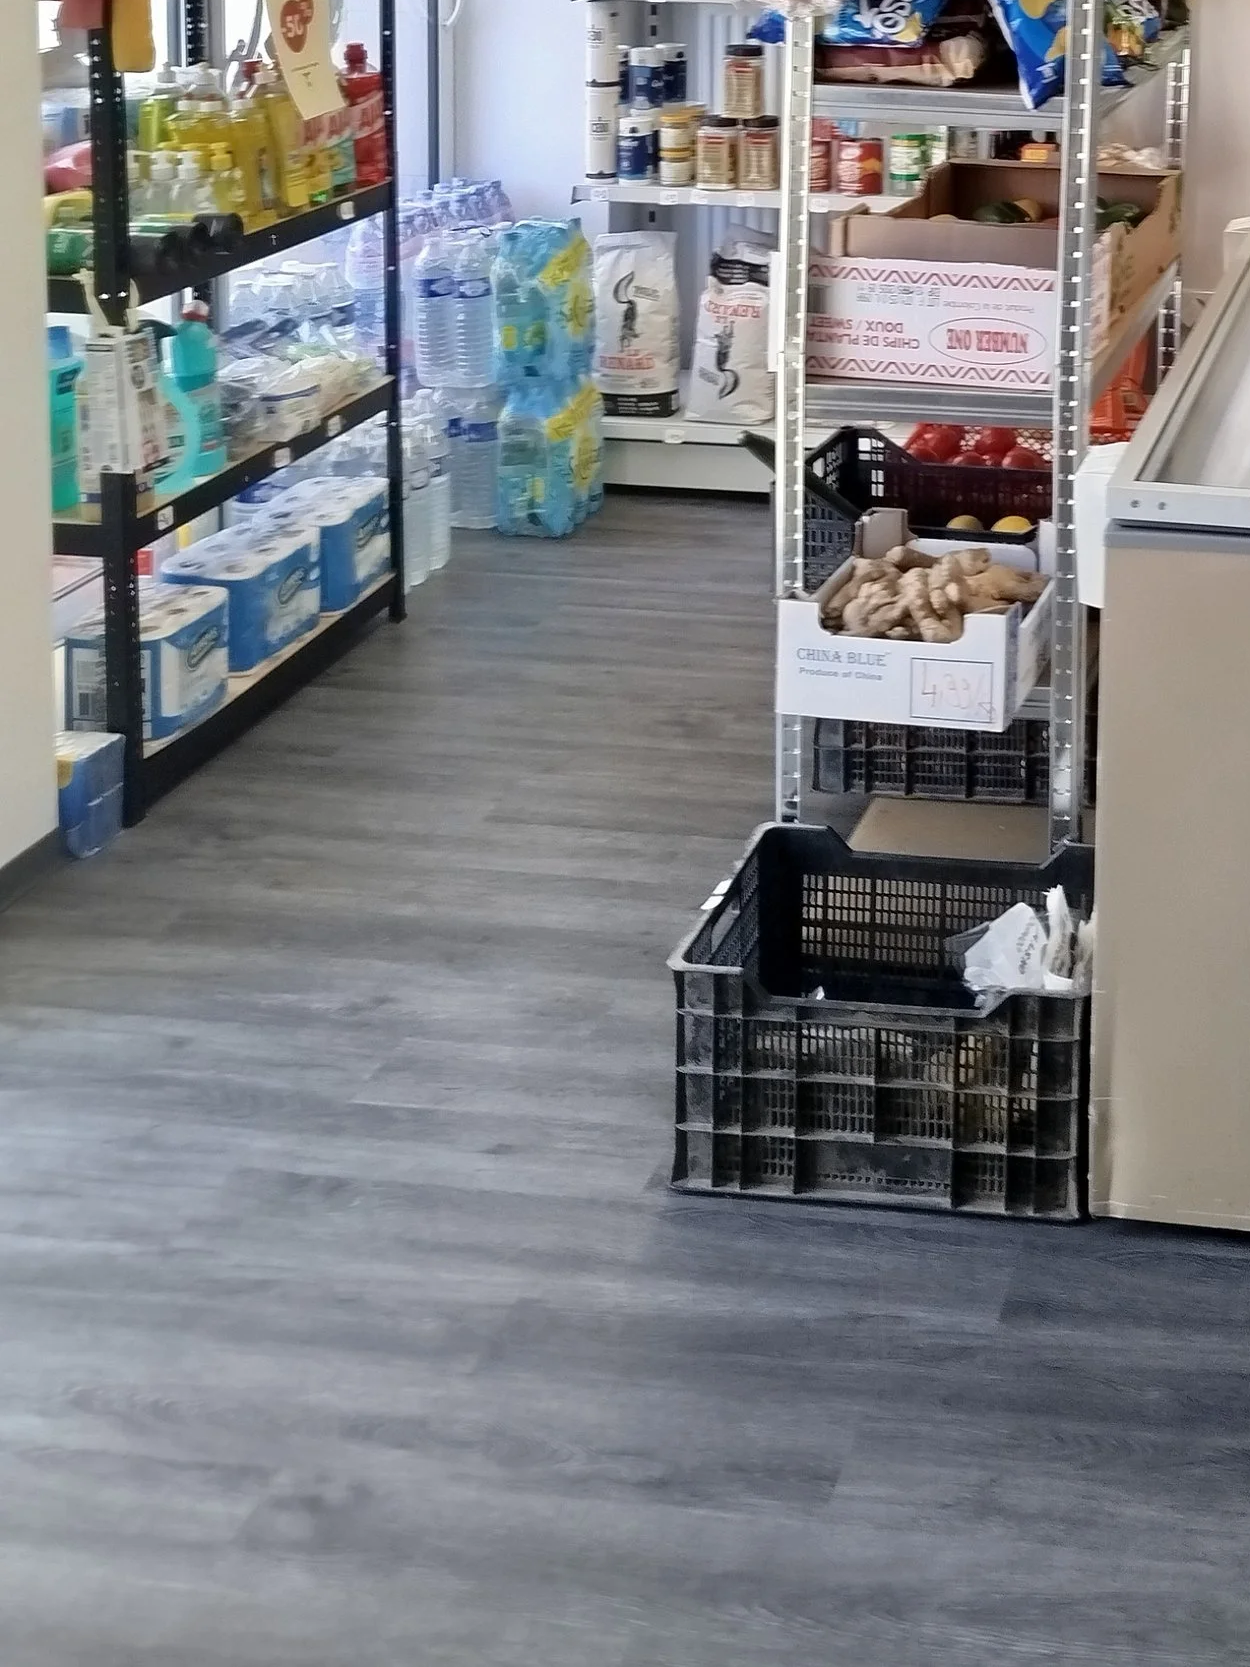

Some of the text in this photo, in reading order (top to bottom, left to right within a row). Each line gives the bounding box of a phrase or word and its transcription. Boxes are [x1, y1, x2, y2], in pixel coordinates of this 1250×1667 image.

[865, 320, 904, 334] DOUX
[863, 336, 878, 347] DE
[882, 337, 920, 350] CHIPS
[946, 328, 1029, 354] NUMBER ONE
[796, 647, 887, 667] CHINA BLUE
[799, 666, 883, 681] Produce of China
